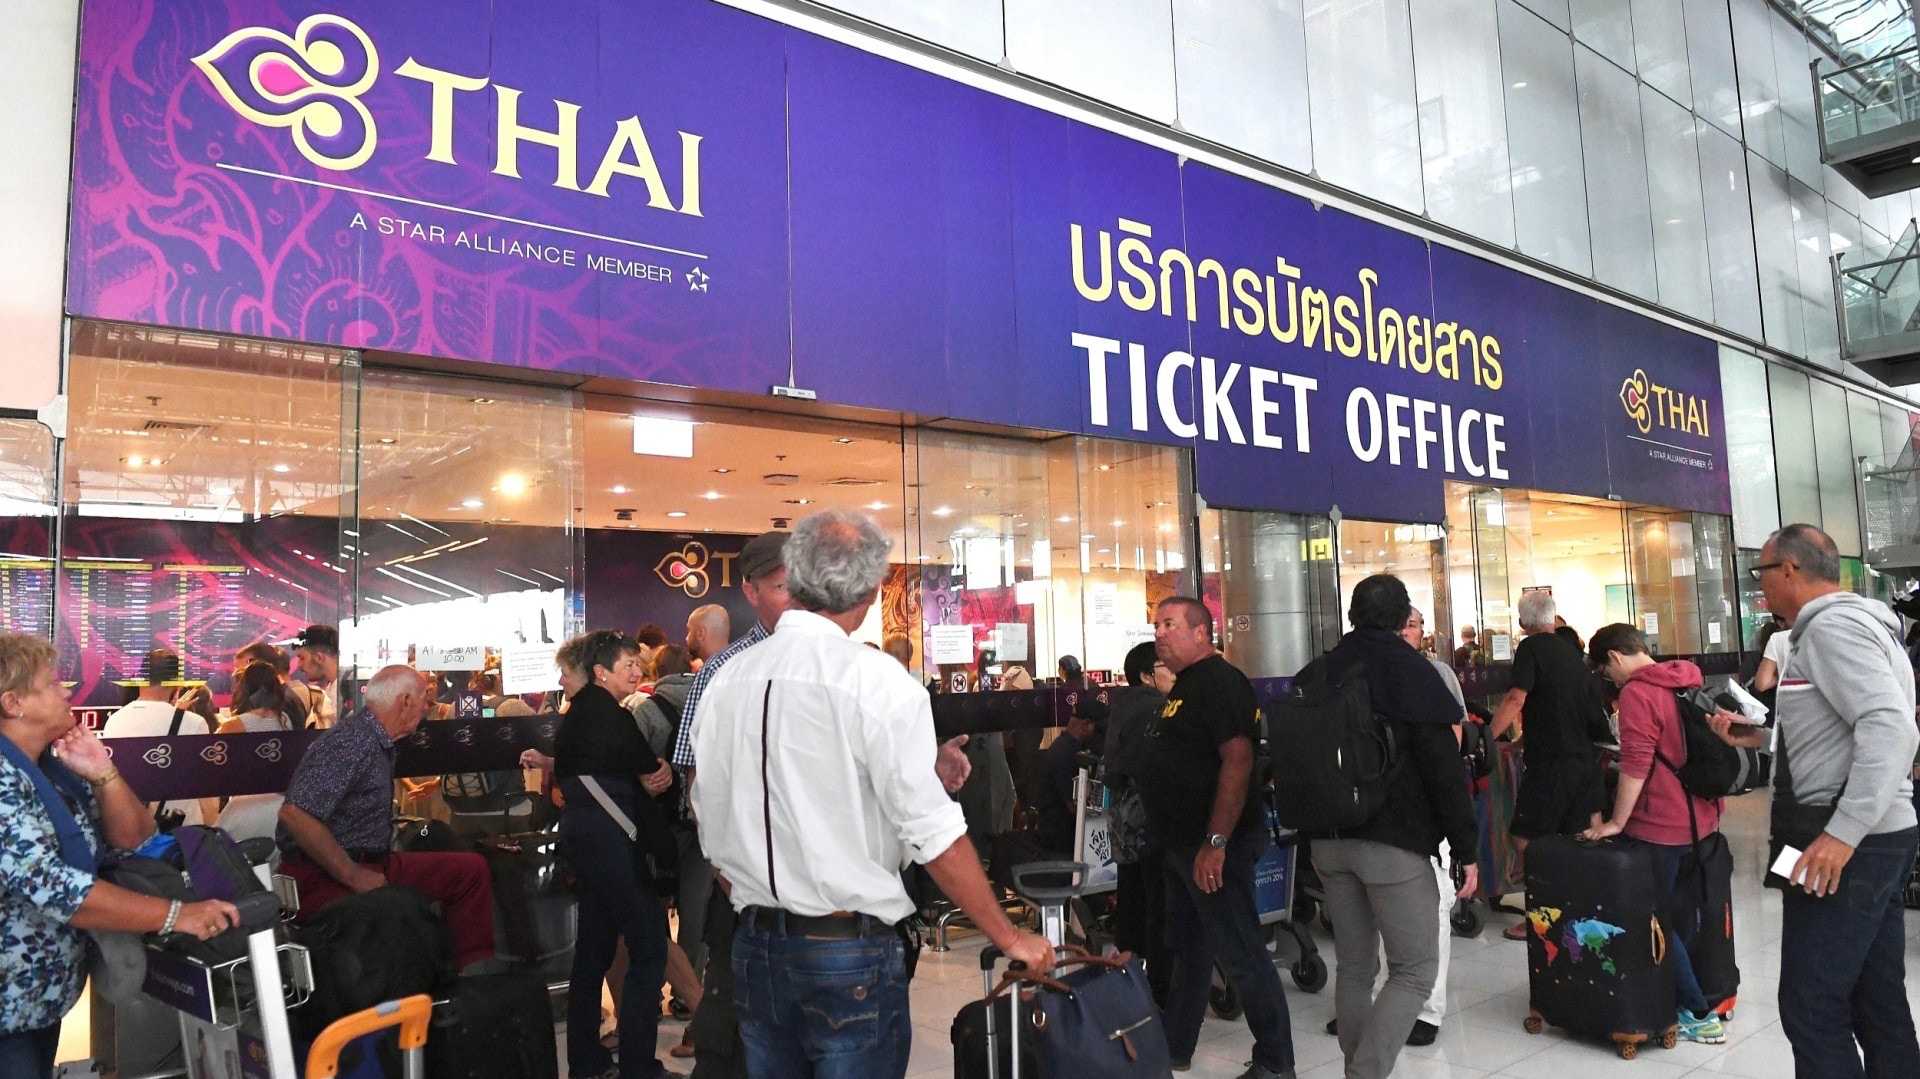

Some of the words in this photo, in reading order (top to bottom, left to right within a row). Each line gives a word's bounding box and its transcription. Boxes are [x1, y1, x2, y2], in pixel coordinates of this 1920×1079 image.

[394, 56, 704, 218] THAI
[350, 213, 367, 230] A
[378, 217, 445, 244] STAR
[454, 231, 576, 267] ALLIANCE
[587, 253, 672, 284] MEMBER
[1070, 217, 1504, 391] บริการบัตรโดยสาร
[1071, 332, 1318, 454] TICKET
[1345, 386, 1510, 481] OFFICE
[1651, 383, 1710, 438] THAI
[1667, 453, 1689, 465] ALLIANCE
[1689, 458, 1707, 469] MEMBER
